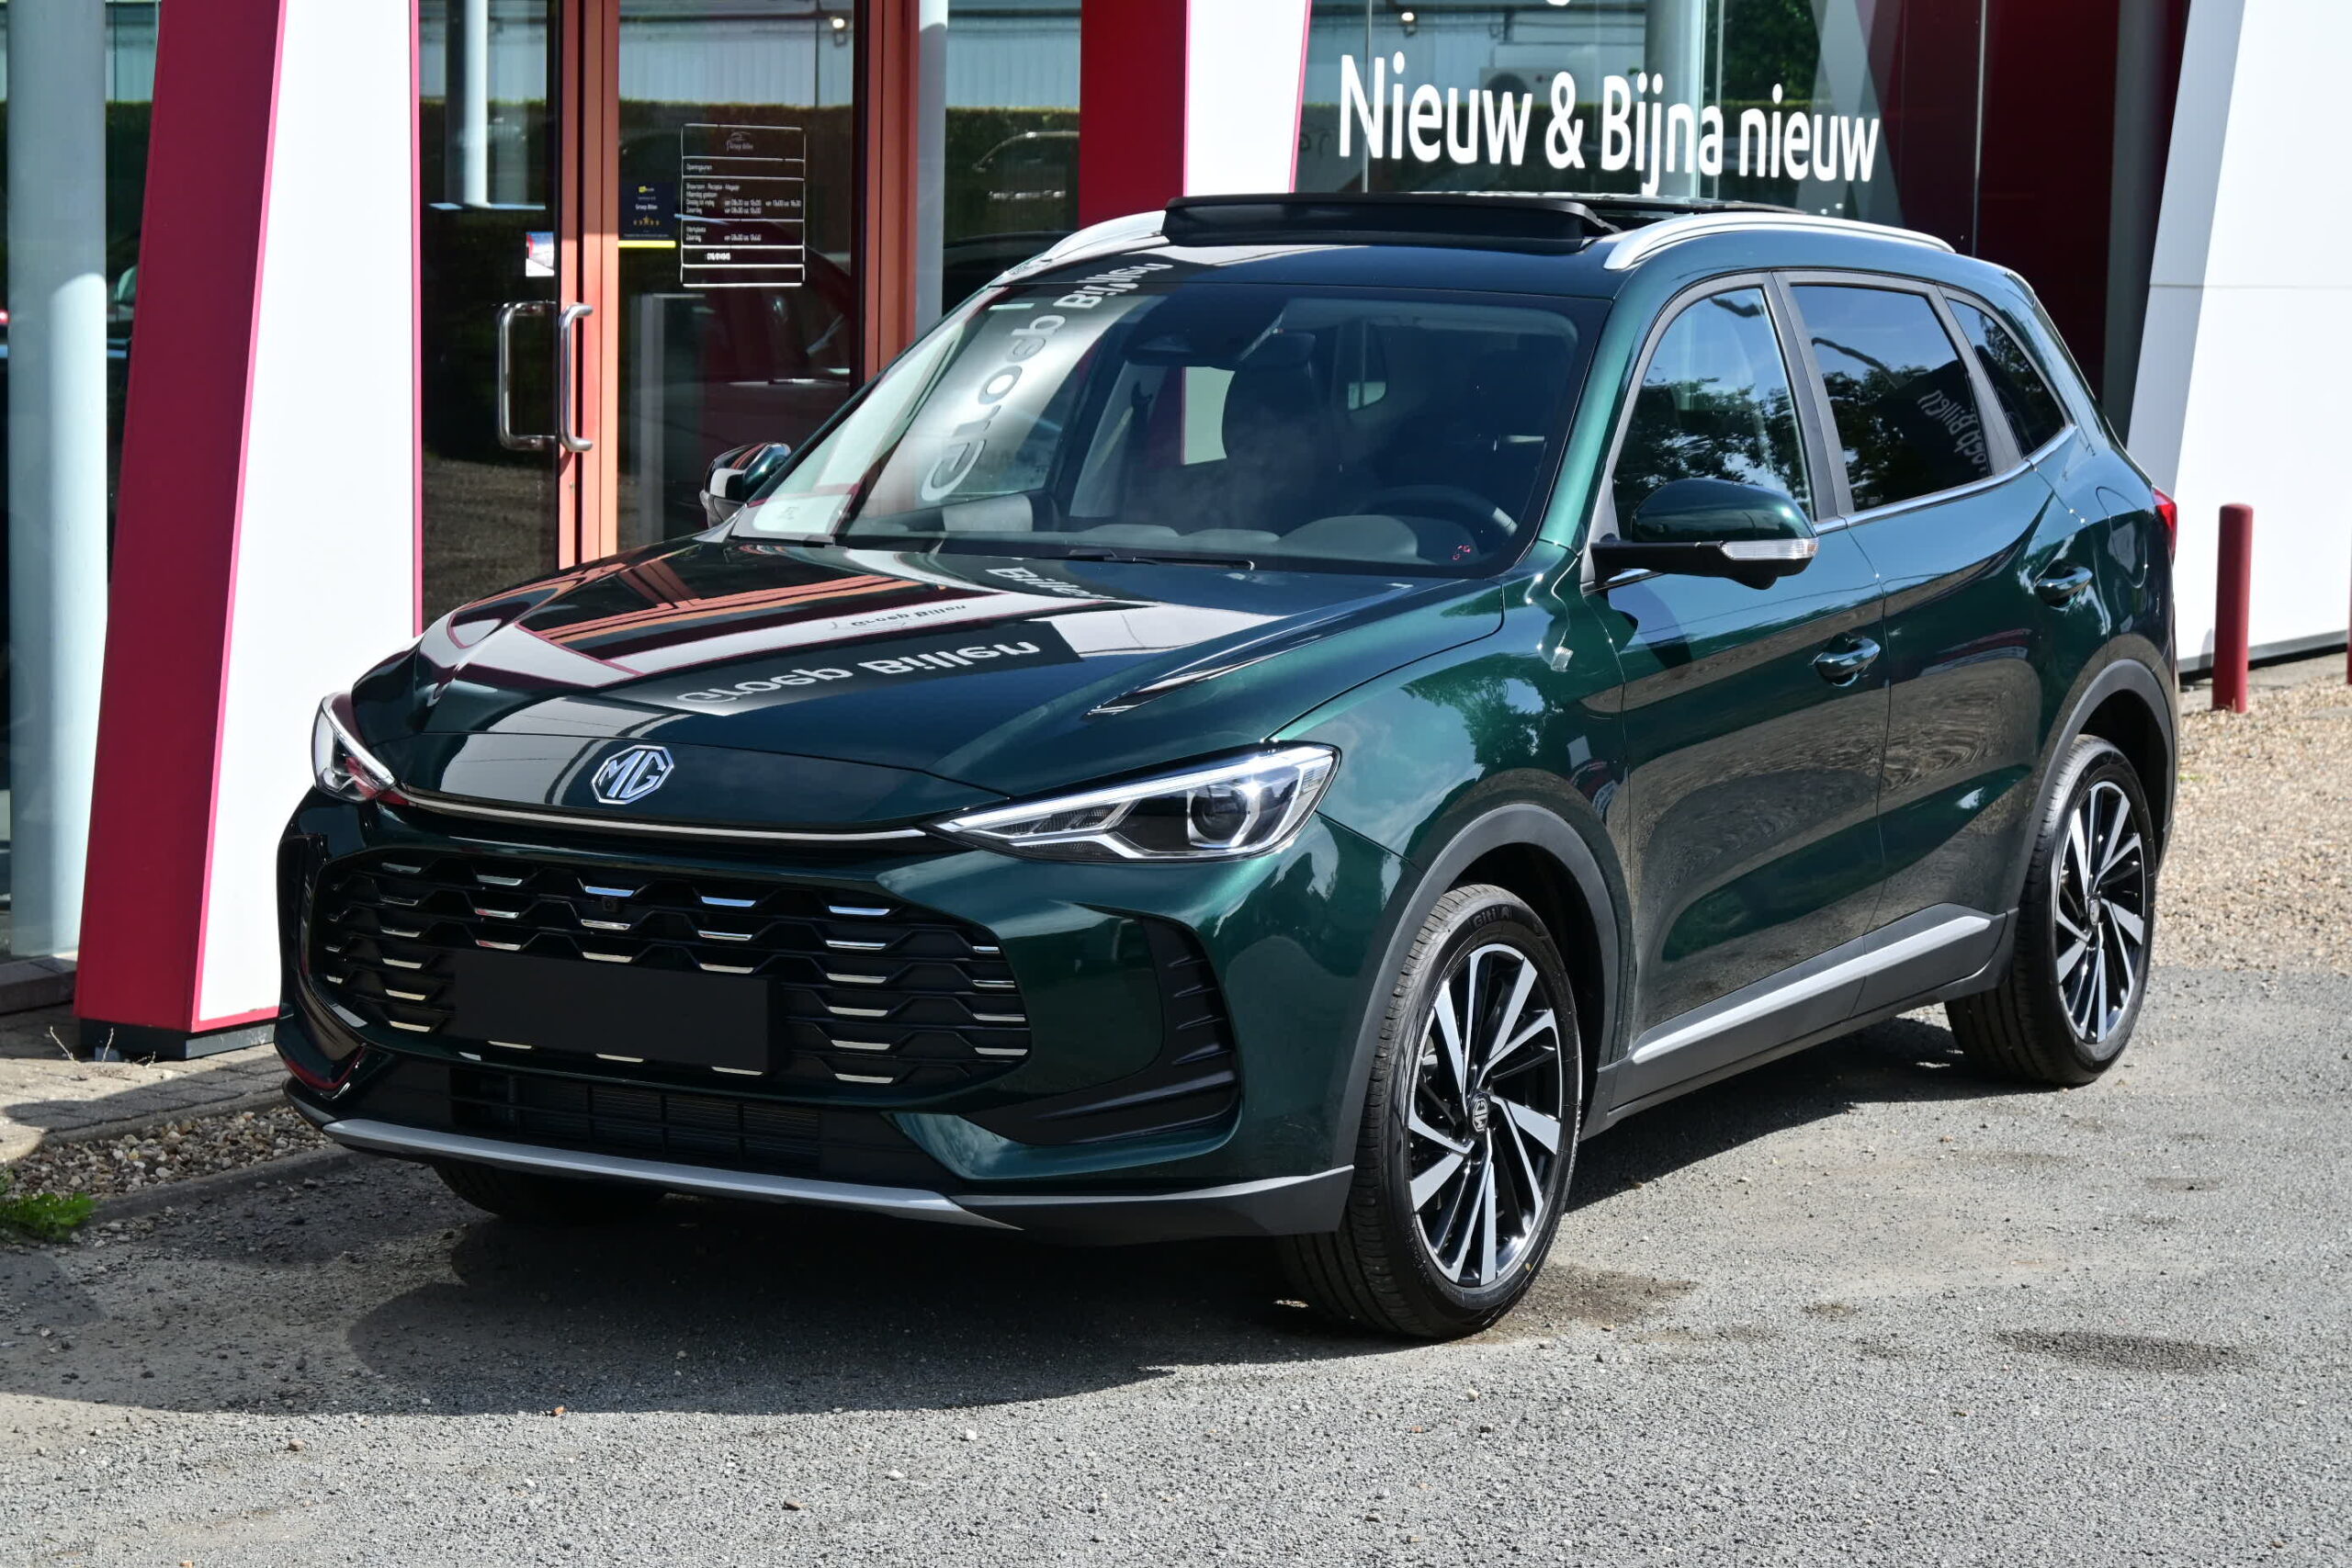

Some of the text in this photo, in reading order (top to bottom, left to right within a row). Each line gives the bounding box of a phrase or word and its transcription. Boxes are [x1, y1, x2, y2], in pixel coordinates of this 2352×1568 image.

[1339, 51, 1881, 196] Nieuw & Bijna nieuw
[593, 747, 673, 803] MG
